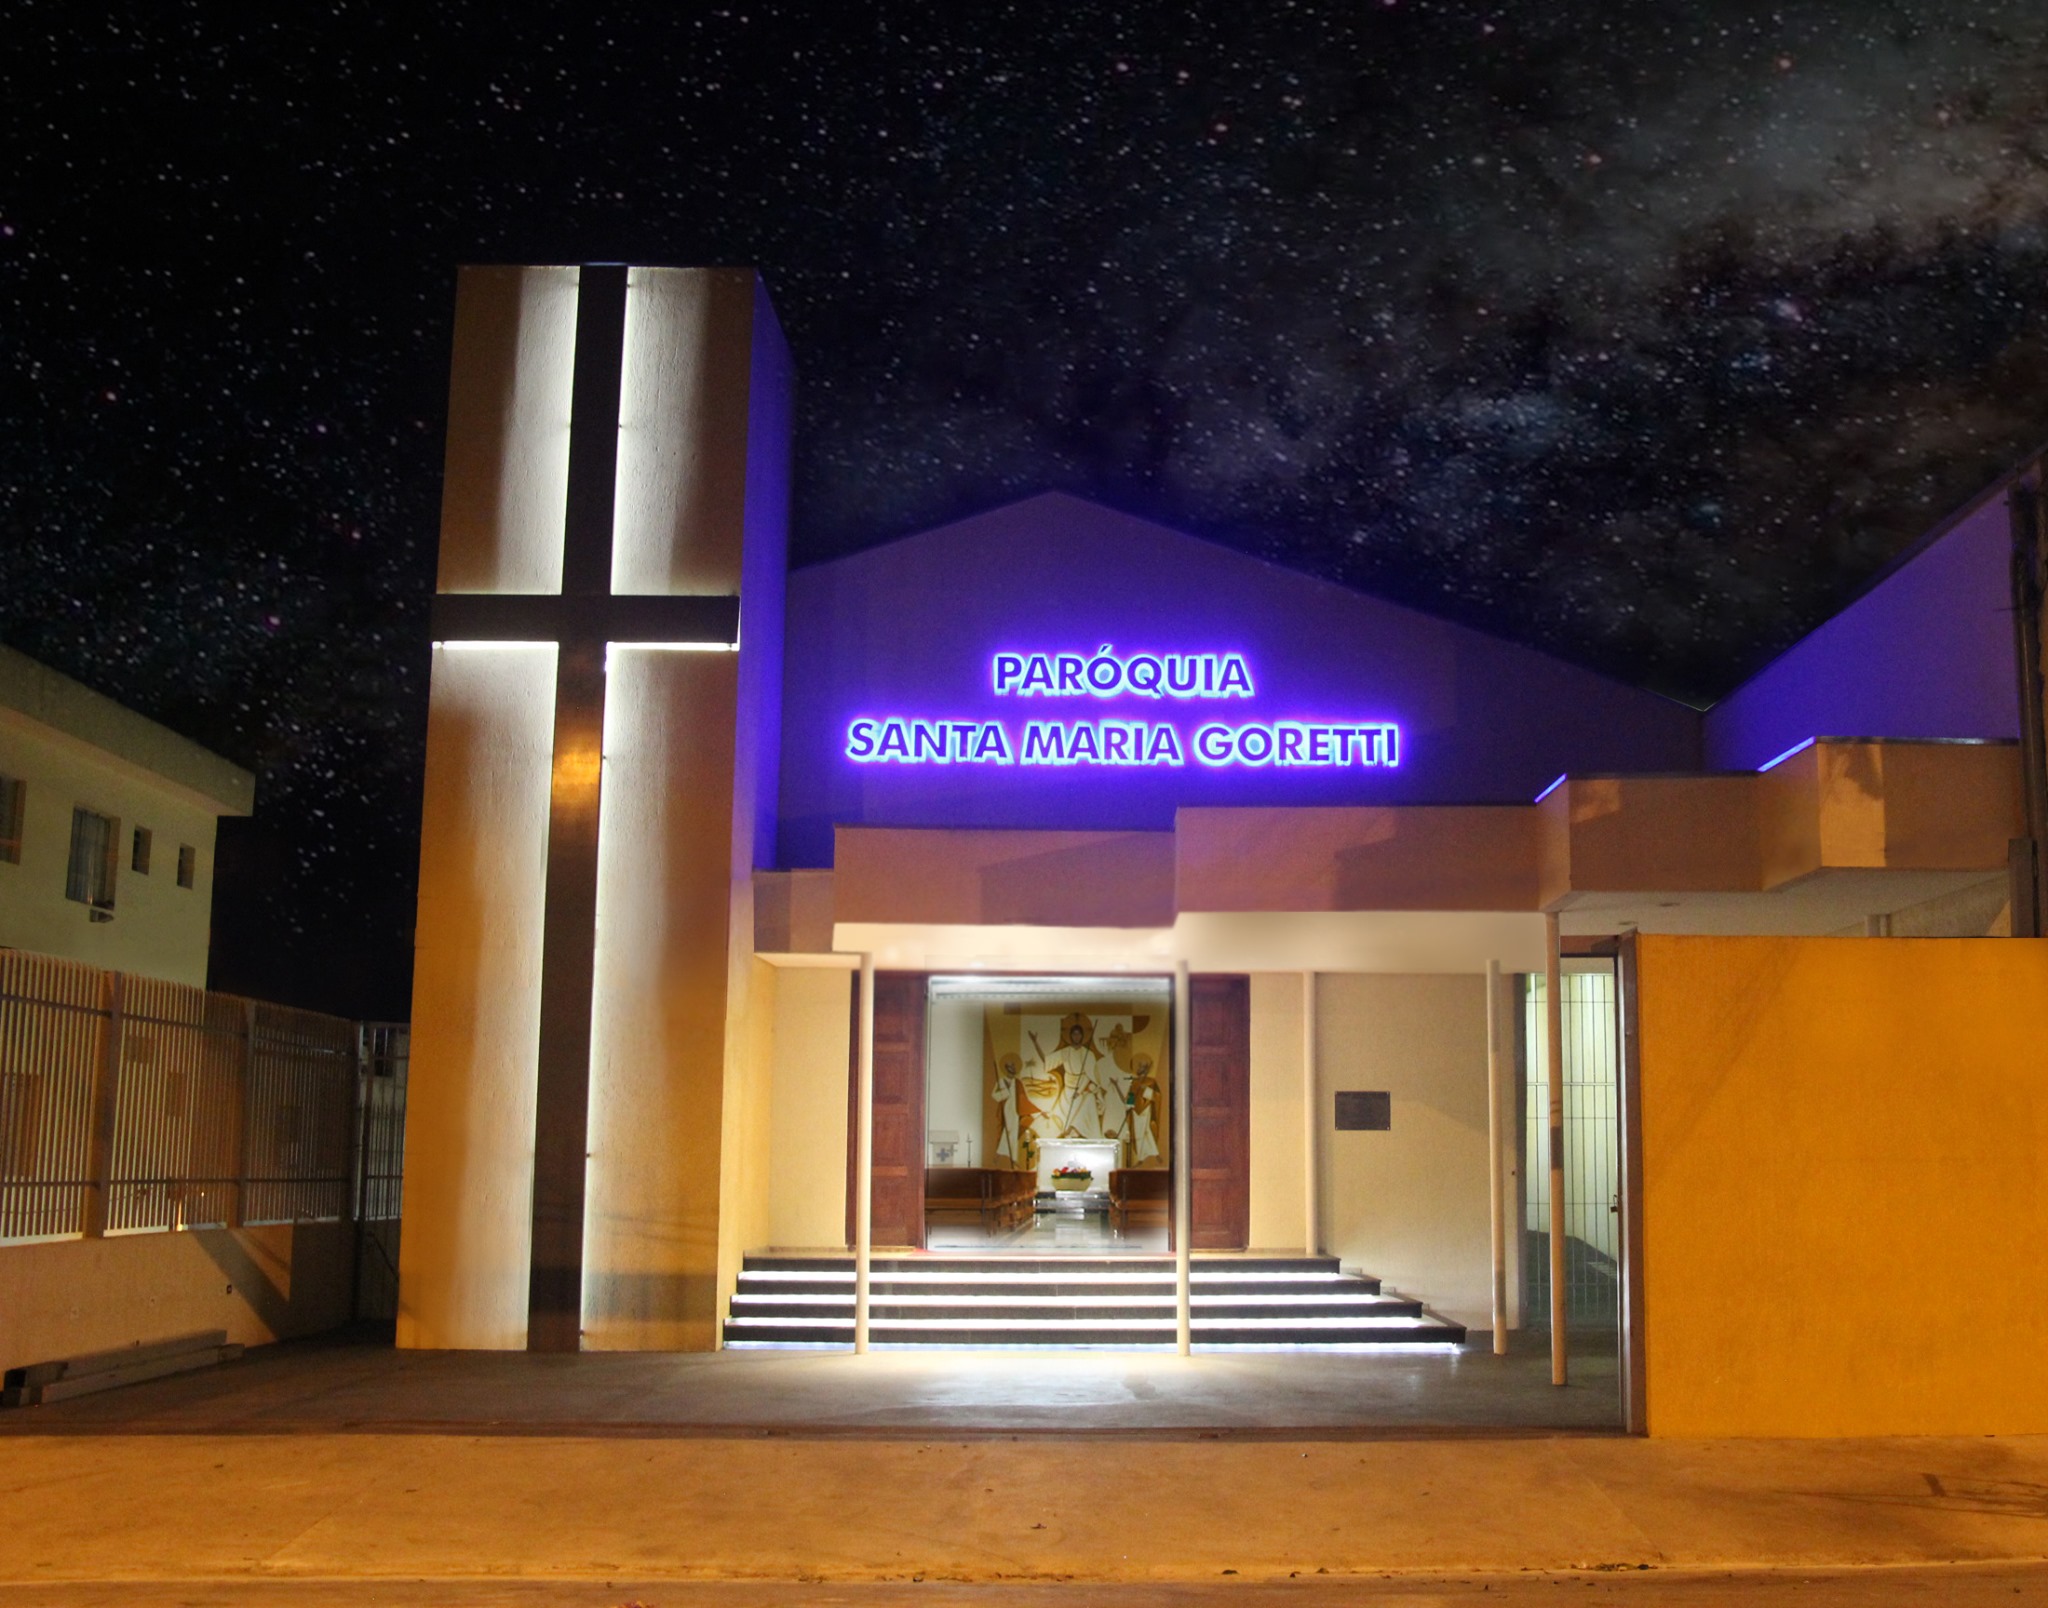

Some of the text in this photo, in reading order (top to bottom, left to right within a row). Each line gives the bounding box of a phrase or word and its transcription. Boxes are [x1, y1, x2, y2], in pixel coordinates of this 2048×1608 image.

[995, 645, 1252, 696] PARÓQUIA
[848, 721, 1398, 765] SANTA MARIA GORETTI
